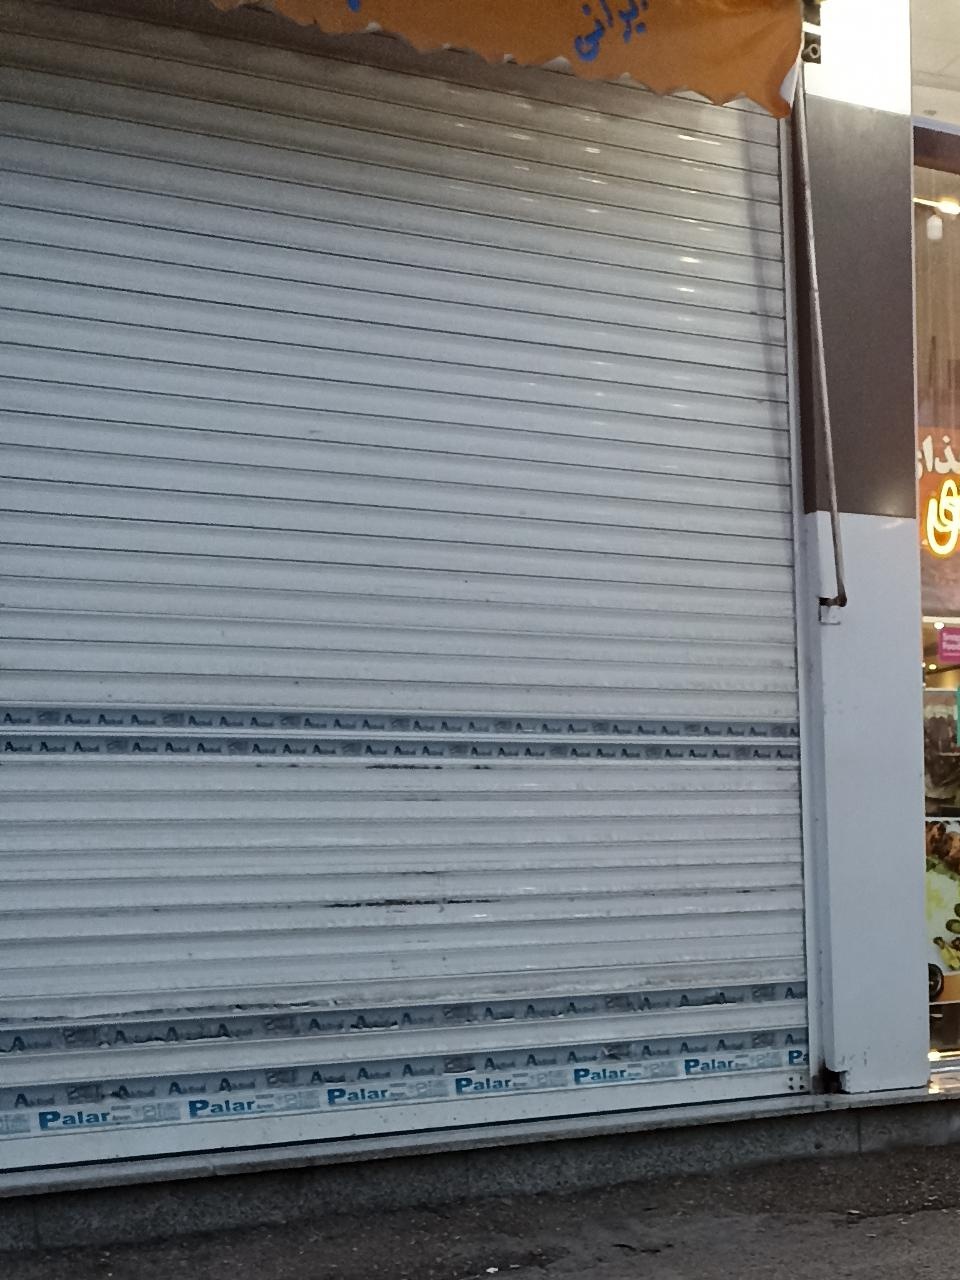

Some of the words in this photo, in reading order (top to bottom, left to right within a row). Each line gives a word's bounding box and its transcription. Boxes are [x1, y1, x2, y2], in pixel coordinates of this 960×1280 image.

[38, 1110, 110, 1131] Palar
[187, 1098, 257, 1120] Palar
[326, 1087, 389, 1106] Palar
[453, 1076, 512, 1095] Palar
[572, 1067, 628, 1085] Palar
[683, 1058, 734, 1075] Palar
